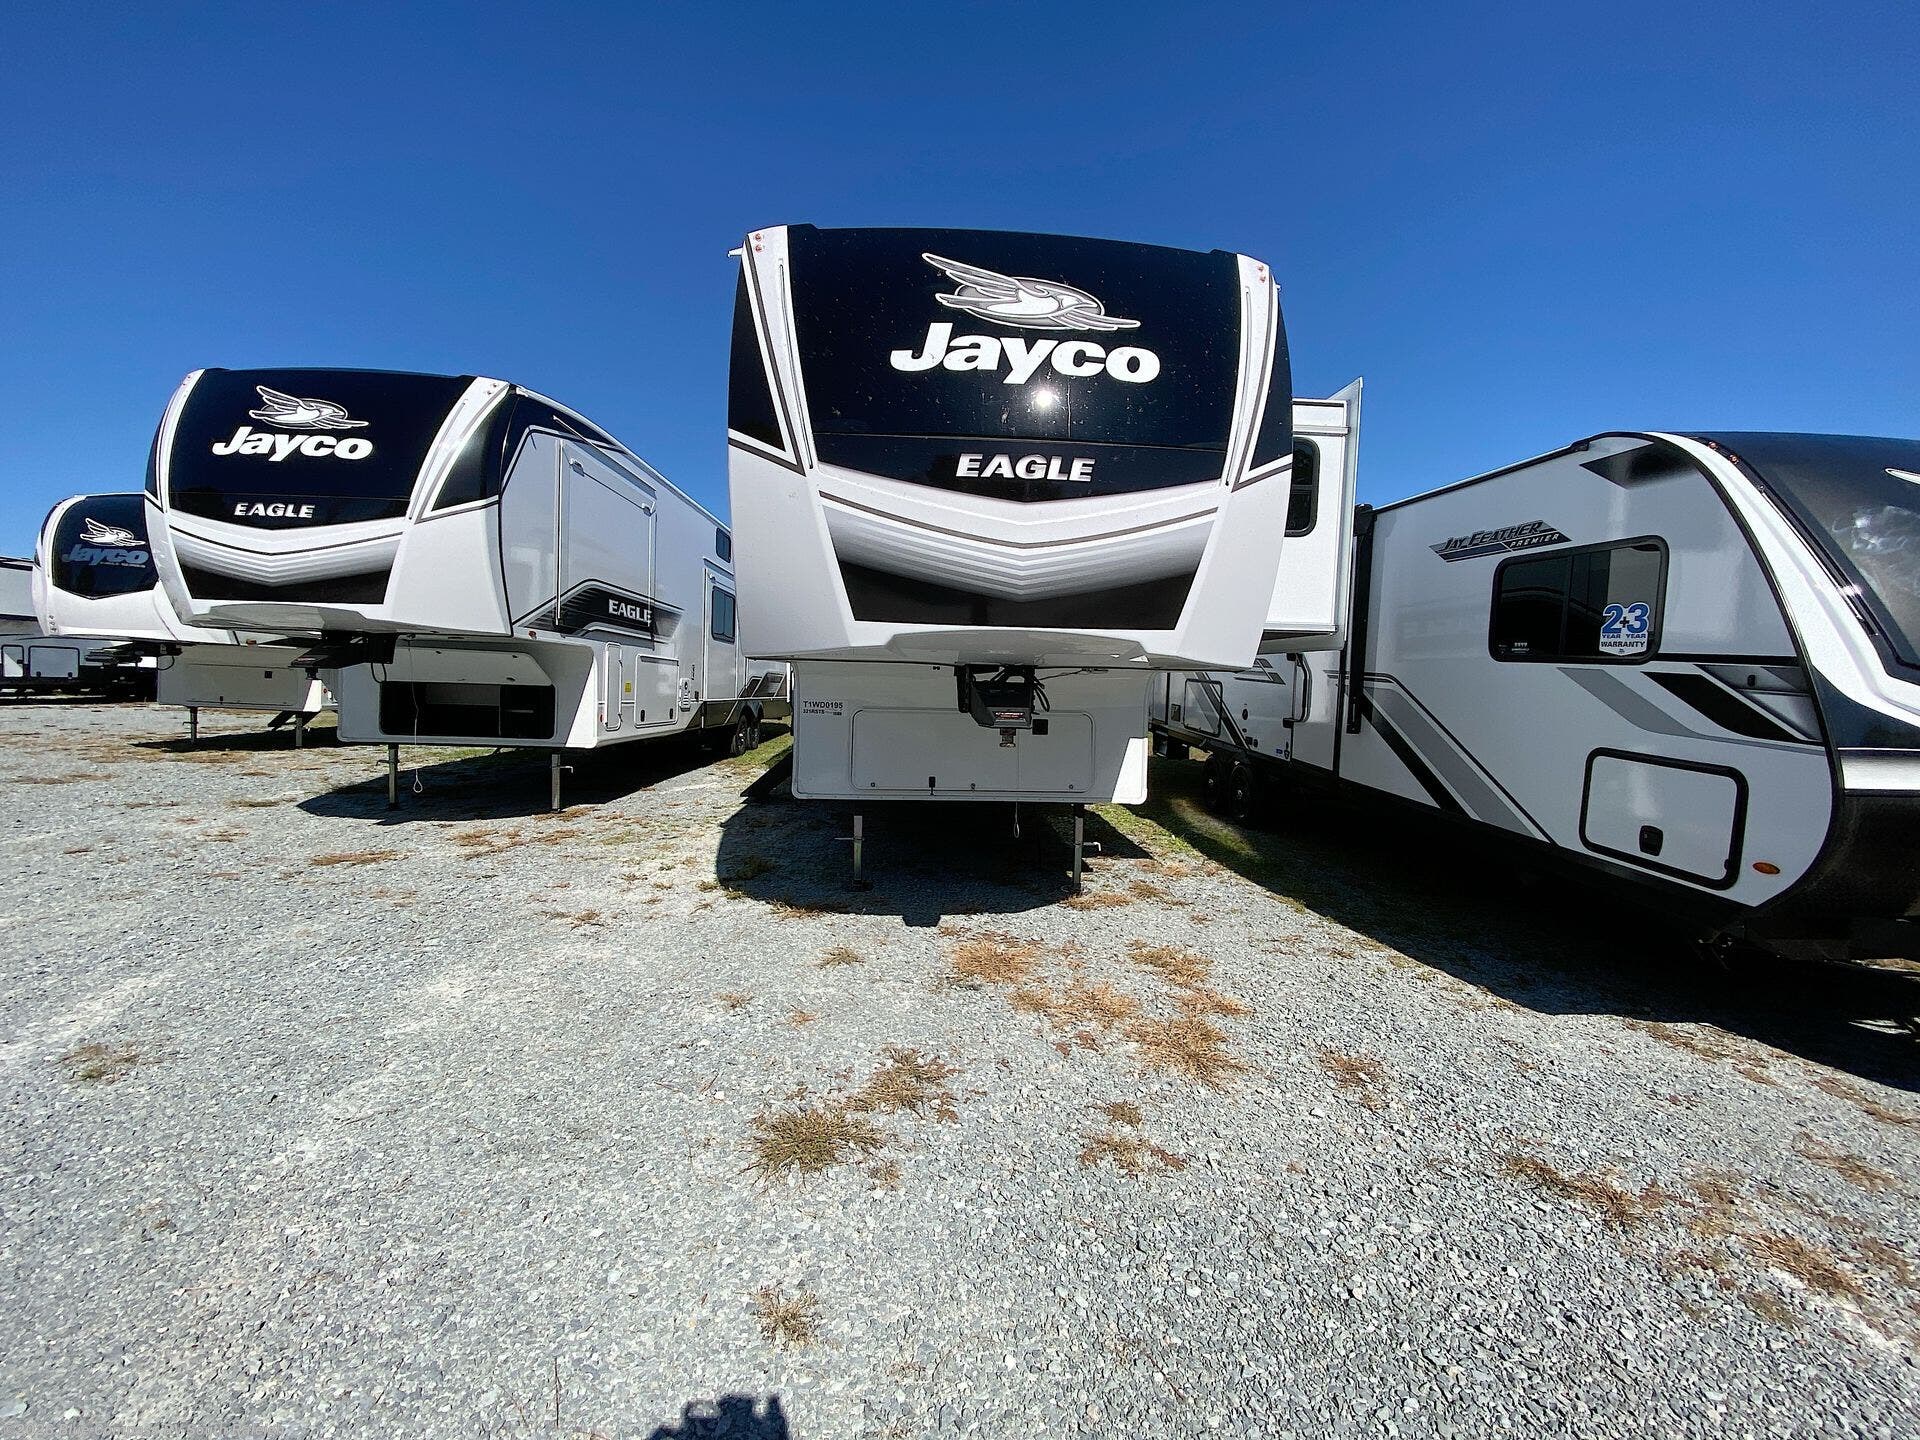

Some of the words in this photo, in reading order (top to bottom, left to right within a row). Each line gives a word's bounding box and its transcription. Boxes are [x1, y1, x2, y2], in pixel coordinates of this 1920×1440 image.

[889, 322, 1161, 385] Jayco
[211, 426, 374, 462] Jayco
[955, 453, 1096, 482] EAGLE
[234, 502, 316, 519] EAGLE
[1443, 537, 1470, 550] JAY
[1468, 520, 1544, 545] FEATHER
[1509, 533, 1560, 548] PREMIER
[62, 544, 149, 565] Jayco
[608, 599, 653, 623] EAGLE
[803, 700, 843, 709] T1WD0195
